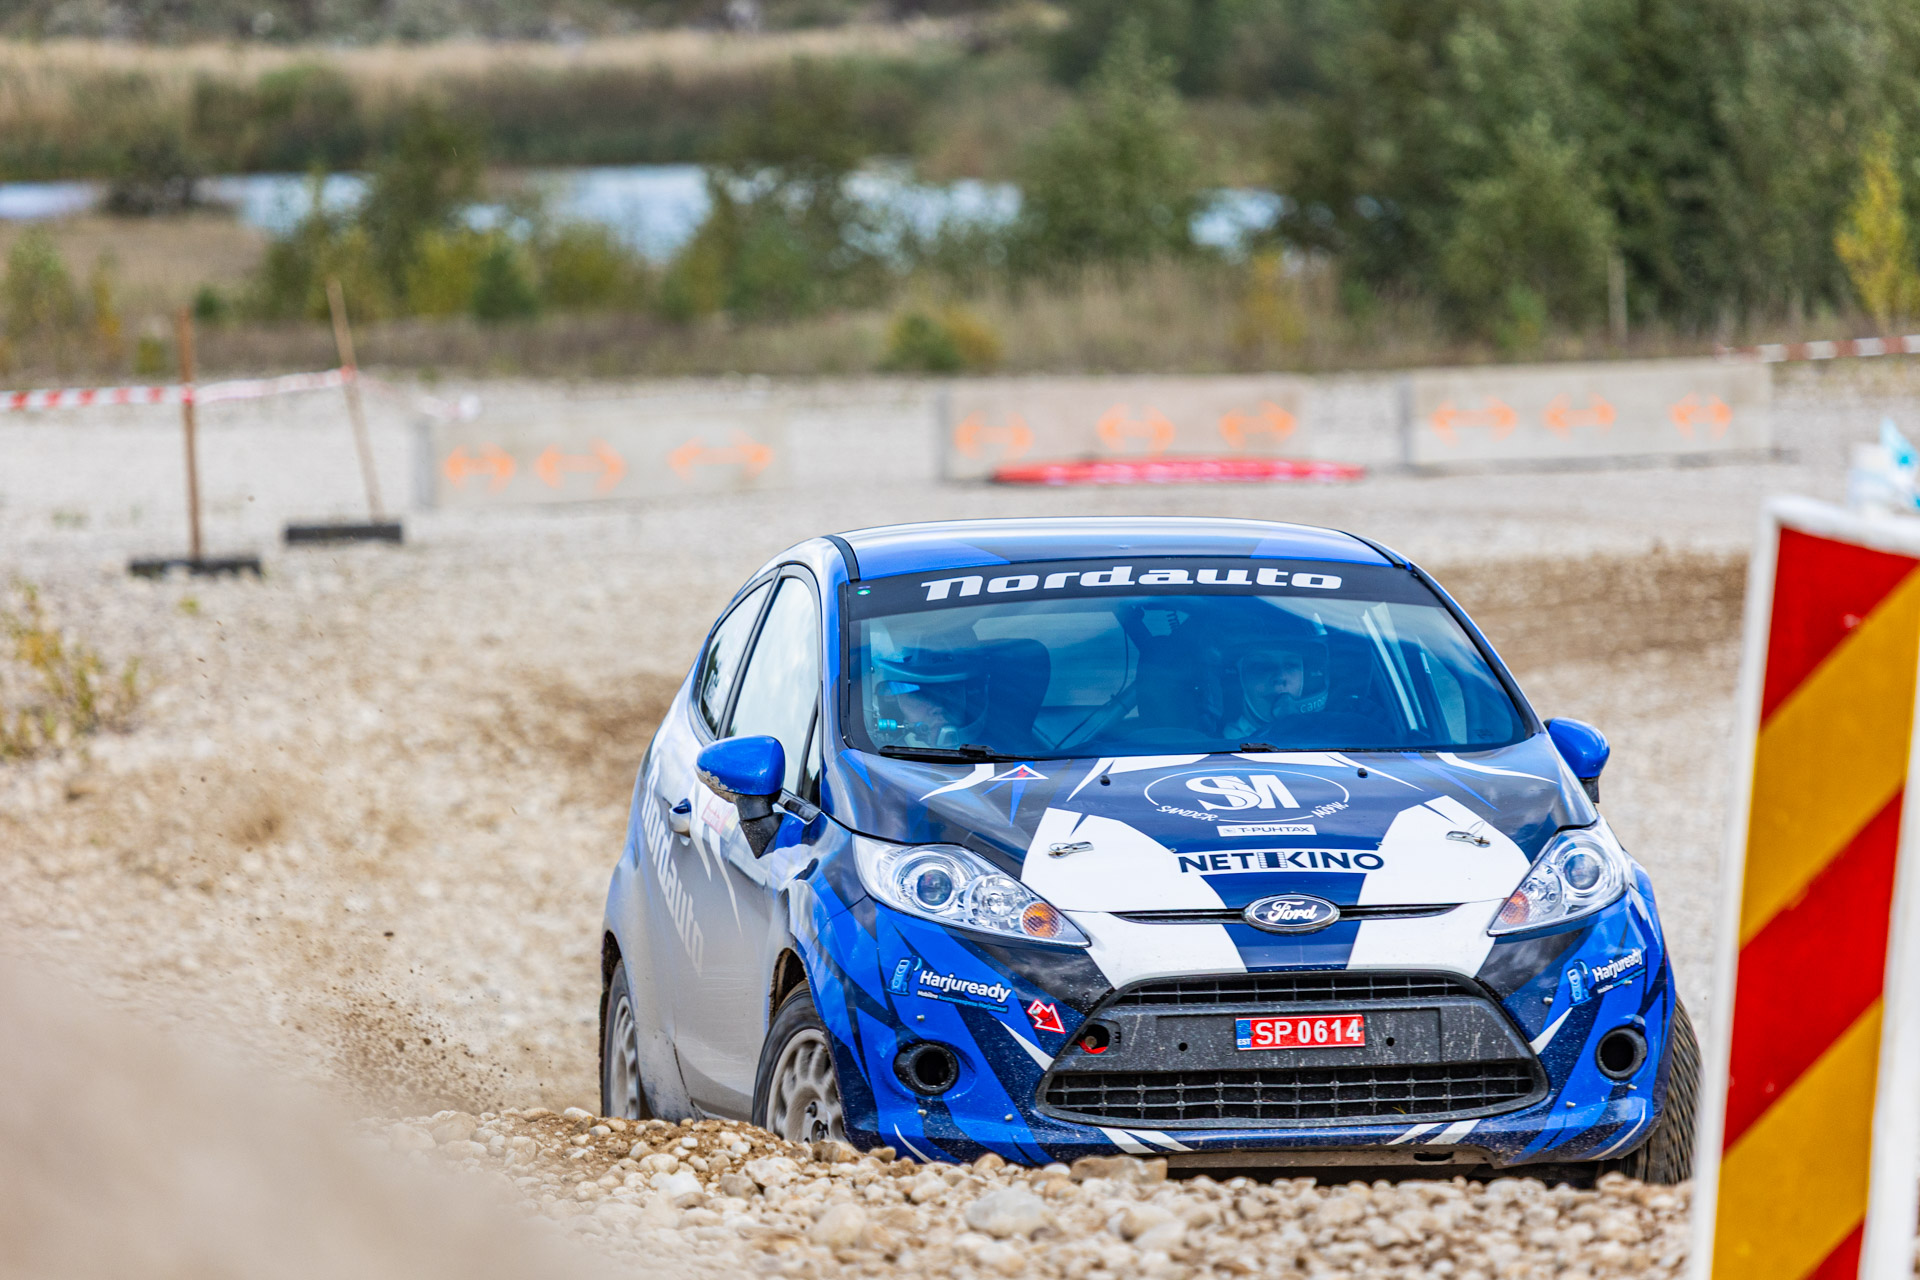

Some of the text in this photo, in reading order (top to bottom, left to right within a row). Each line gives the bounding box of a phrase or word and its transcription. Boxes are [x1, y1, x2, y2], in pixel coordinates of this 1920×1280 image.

[1266, 900, 1317, 921] Ford
[1592, 948, 1643, 982] Harjuready
[920, 969, 1012, 1002] Harjuready
[1237, 1038, 1251, 1046] EST
[1255, 1019, 1360, 1045] SP 0614
